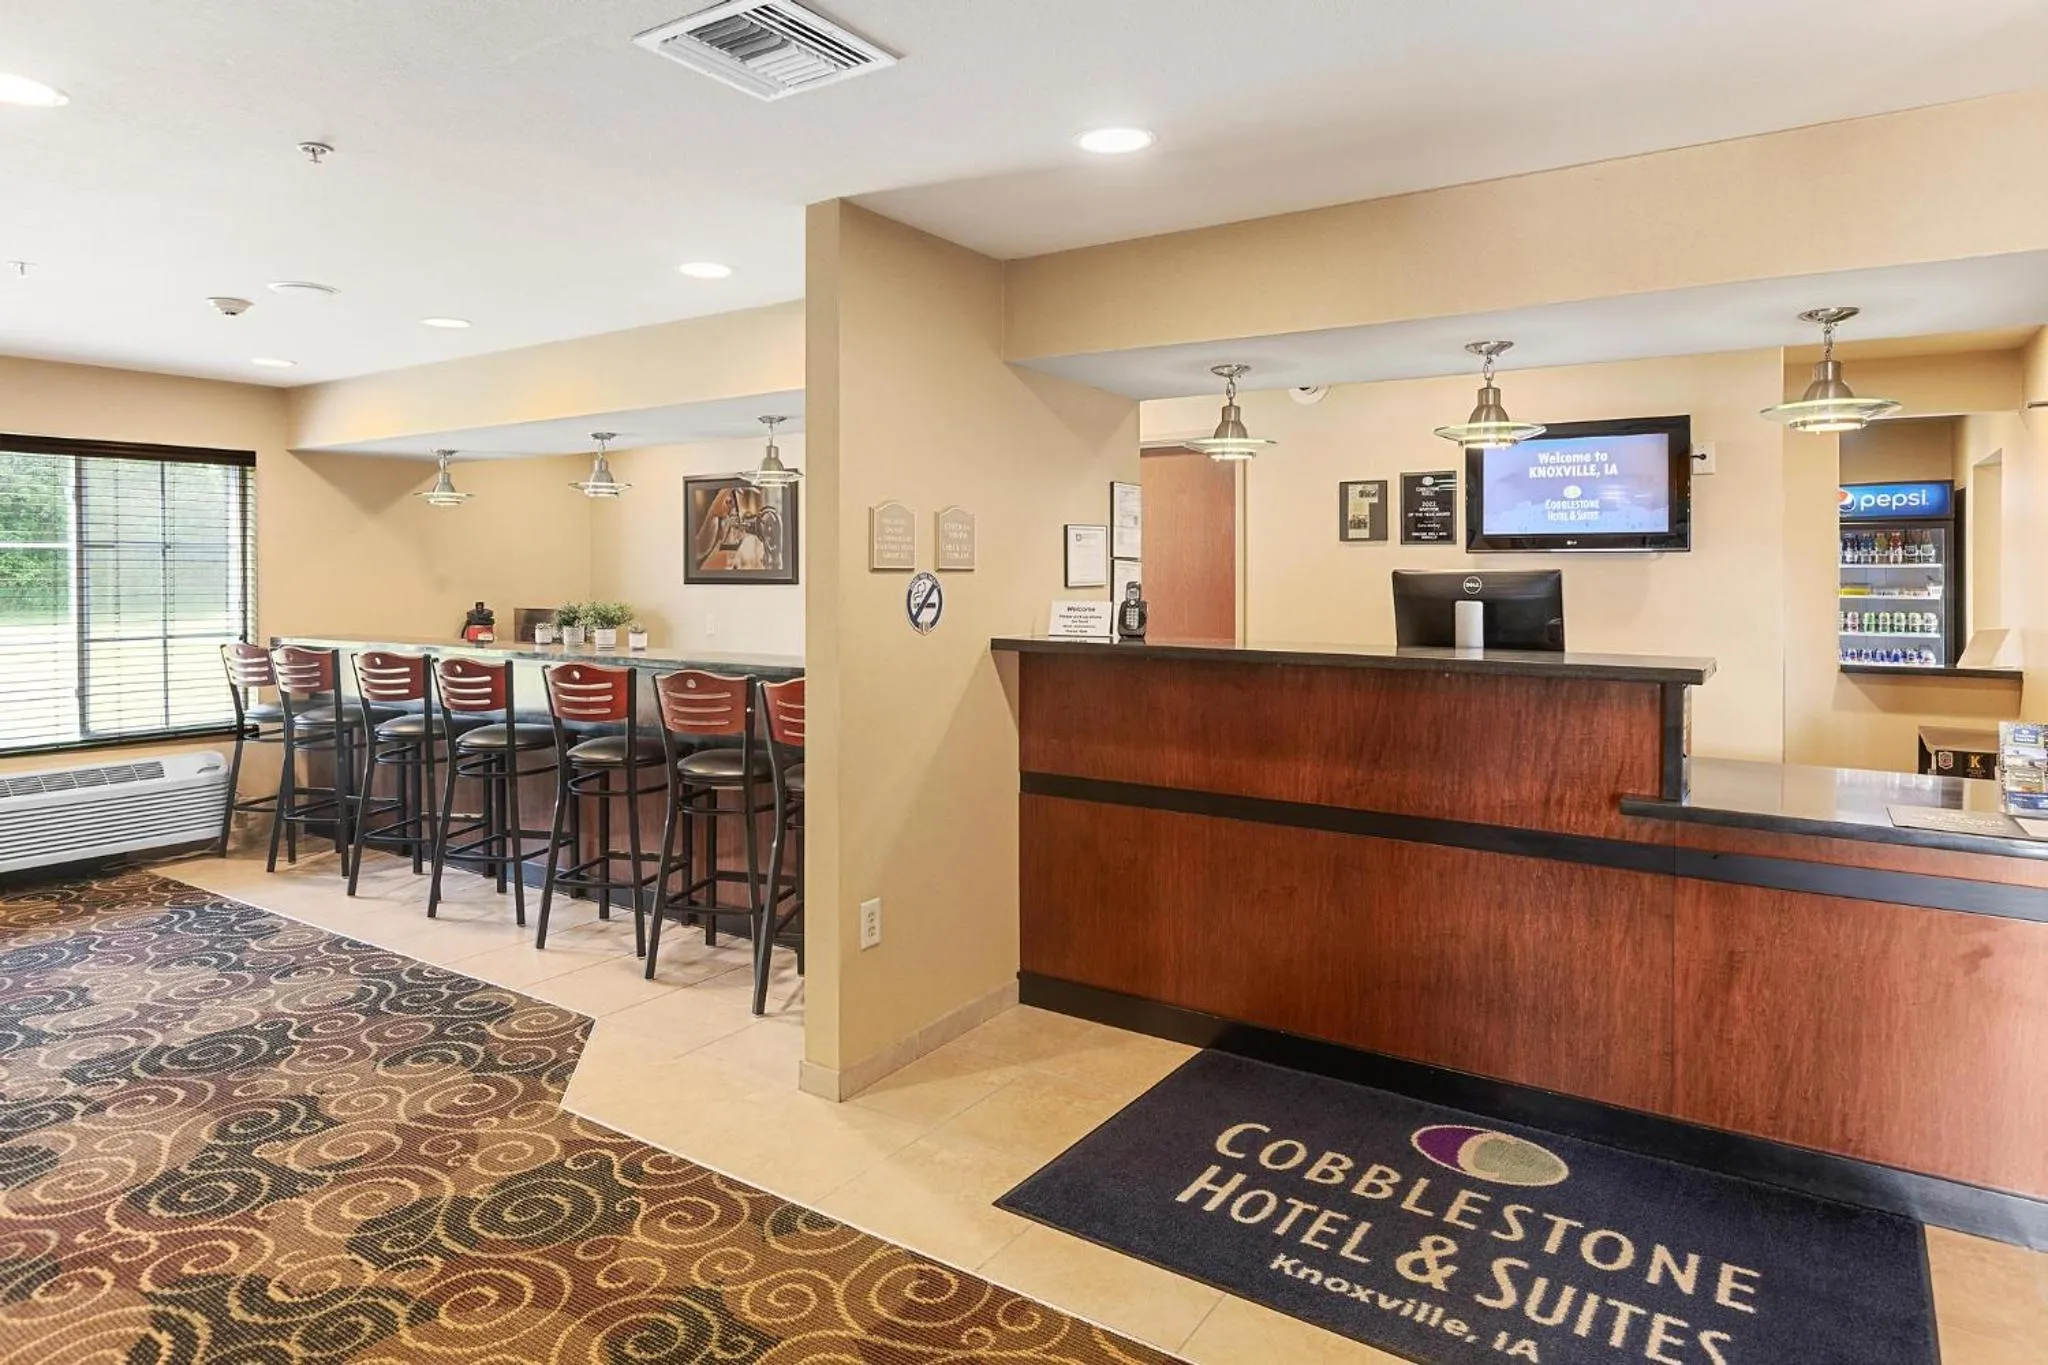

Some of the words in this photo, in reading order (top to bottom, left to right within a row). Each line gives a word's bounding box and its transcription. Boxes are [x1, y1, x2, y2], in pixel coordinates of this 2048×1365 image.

[1529, 463, 1600, 478] KNOXVILLE,
[1604, 463, 1618, 475] IA
[1538, 451, 1591, 464] Welcome
[1594, 451, 1608, 461] to
[1860, 489, 1926, 511] pepsi
[1215, 1123, 1761, 1314] COBBLESTONE
[1175, 1164, 1373, 1264] HOTEL
[1395, 1235, 1458, 1291] &
[1474, 1257, 1731, 1365] SUITES
[1269, 1253, 1480, 1343] Knoxville,
[1492, 1331, 1540, 1364] IA
